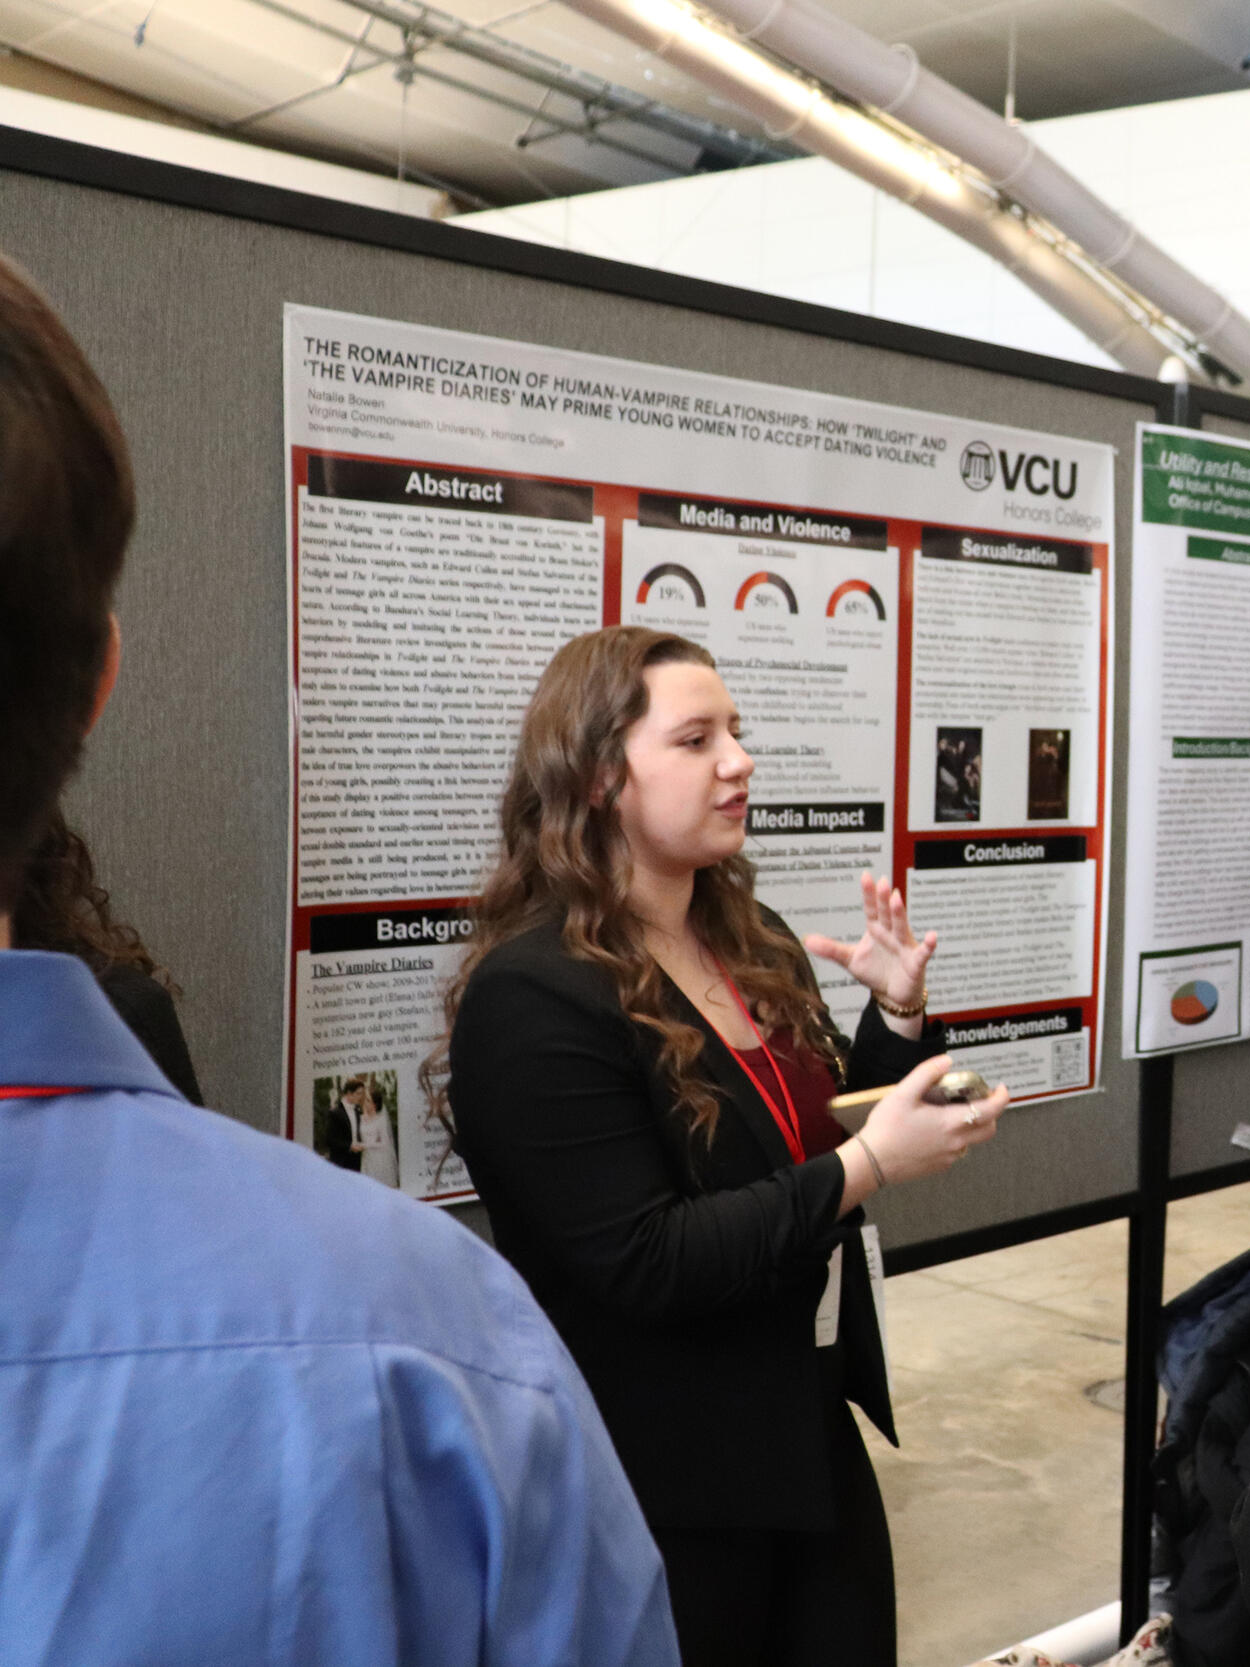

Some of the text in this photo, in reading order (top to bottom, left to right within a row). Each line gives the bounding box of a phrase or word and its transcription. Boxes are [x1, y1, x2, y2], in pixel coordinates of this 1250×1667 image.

[304, 337, 340, 359] THE
[348, 344, 520, 386] ROMANTICIZATION
[526, 372, 548, 388] OF
[554, 377, 690, 412] HUMAN-VAMPIRE
[694, 398, 811, 429] RELATIONSHIPS:
[817, 420, 848, 434] HOW
[922, 436, 947, 451] AND
[307, 388, 384, 408] Natalie Bowen
[304, 360, 936, 468] 'THE VAMPIRE DIARIES' MAY PRIME YOUNG WOMEN TO ACCEPT DATING VIOLENCE
[307, 405, 347, 420] Virginia
[351, 410, 433, 429] Commonwealth
[492, 429, 526, 443] Honors
[528, 433, 565, 448] College
[998, 450, 1078, 499] VCU
[1160, 450, 1202, 476] Utility
[1203, 461, 1230, 478] and
[405, 471, 502, 503] Abstract
[1168, 475, 1184, 489] Ali
[302, 502, 315, 512] The
[319, 504, 334, 514] first
[339, 505, 367, 517] literary
[372, 510, 402, 521] vampire
[426, 513, 433, 523] be
[439, 515, 461, 525] traced
[465, 518, 482, 527] back
[1004, 502, 1101, 530] Honors College
[1168, 493, 1200, 510] Office
[1202, 499, 1213, 512] of
[1213, 500, 1250, 518] Campus
[334, 521, 372, 535] Wolfgang
[380, 527, 393, 535] von
[440, 532, 459, 542] poem
[680, 504, 850, 541] Media and Violence
[351, 539, 381, 550] features
[385, 541, 394, 551] of
[405, 545, 434, 555] vampire
[961, 538, 1058, 565] Sexualization
[336, 553, 367, 564] Modern
[411, 559, 428, 569] such
[443, 562, 471, 572] Edward
[475, 564, 497, 575] Cullen
[502, 567, 513, 576] and
[659, 586, 684, 600] 19%
[752, 809, 865, 831] Media Impact
[964, 844, 1044, 862] Conclusion
[377, 917, 473, 942] Backgro
[312, 956, 433, 976] The Vampire Diaries
[312, 983, 344, 995] Popular
[346, 980, 363, 990] CW
[312, 1001, 319, 1009] A
[322, 999, 343, 1008] small
[345, 998, 366, 1006] town
[369, 995, 383, 1005] girl
[385, 992, 415, 1003] (Elena)
[359, 1011, 375, 1019] new
[378, 1010, 392, 1019] guy
[368, 1025, 381, 1033] old
[946, 1016, 1067, 1044] knowledgements
[312, 1039, 359, 1054] Nominated
[361, 1039, 373, 1048] for
[376, 1038, 393, 1047] over
[396, 1036, 412, 1045] 100
[312, 1057, 346, 1069] People's
[382, 1051, 391, 1061] &
